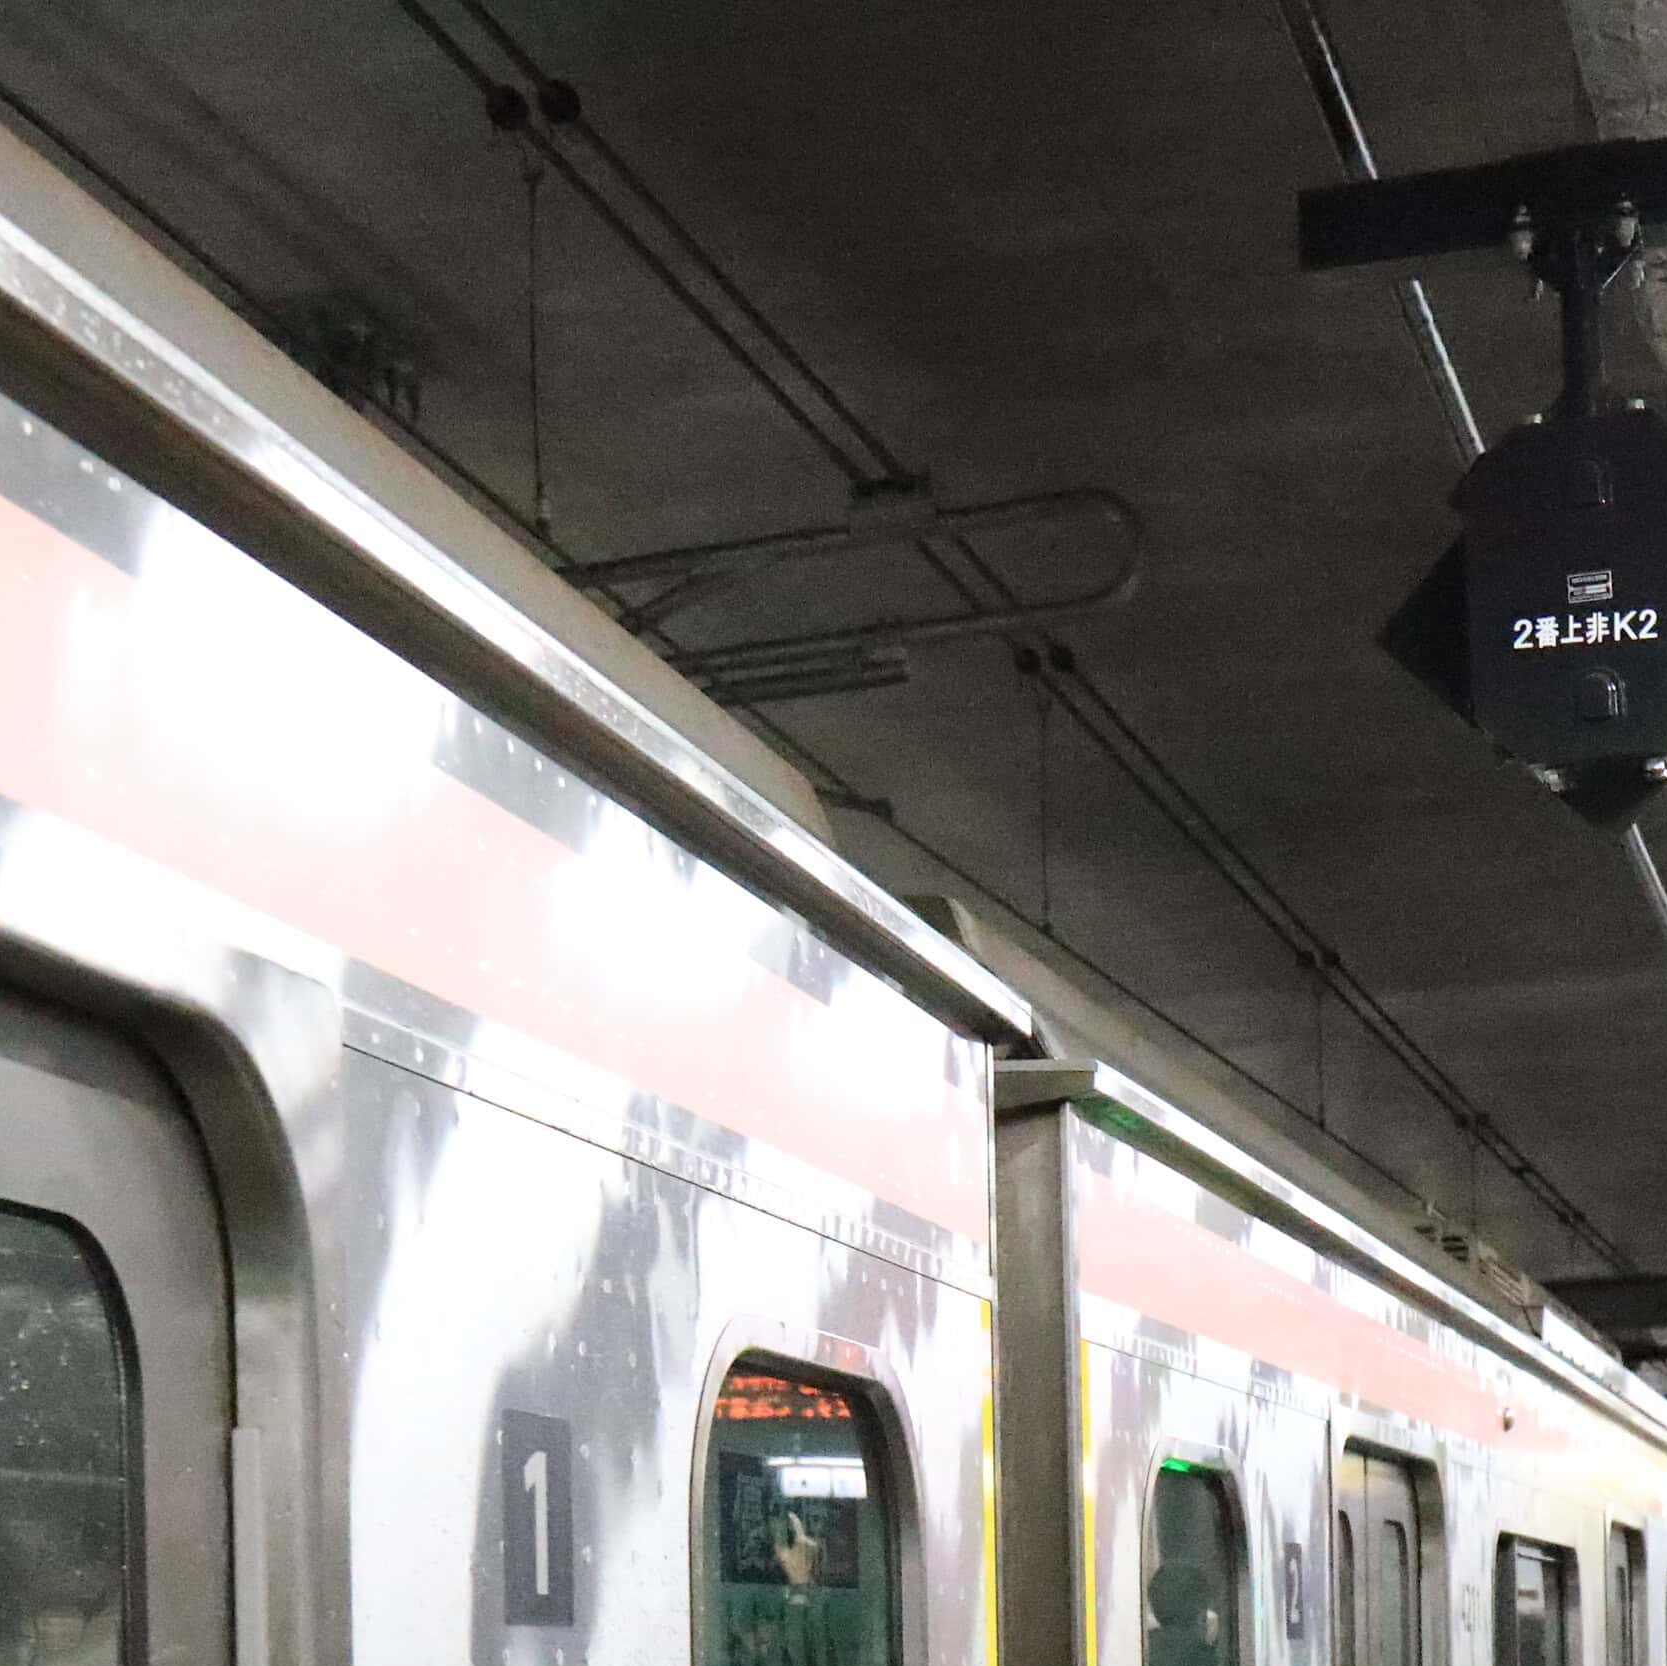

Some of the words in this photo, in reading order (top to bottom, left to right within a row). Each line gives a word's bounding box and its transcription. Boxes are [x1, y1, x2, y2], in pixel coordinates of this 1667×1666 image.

[1513, 609, 1658, 649] 2番上非K2
[524, 1451, 549, 1595] 1
[1290, 1558, 1300, 1623] 2
